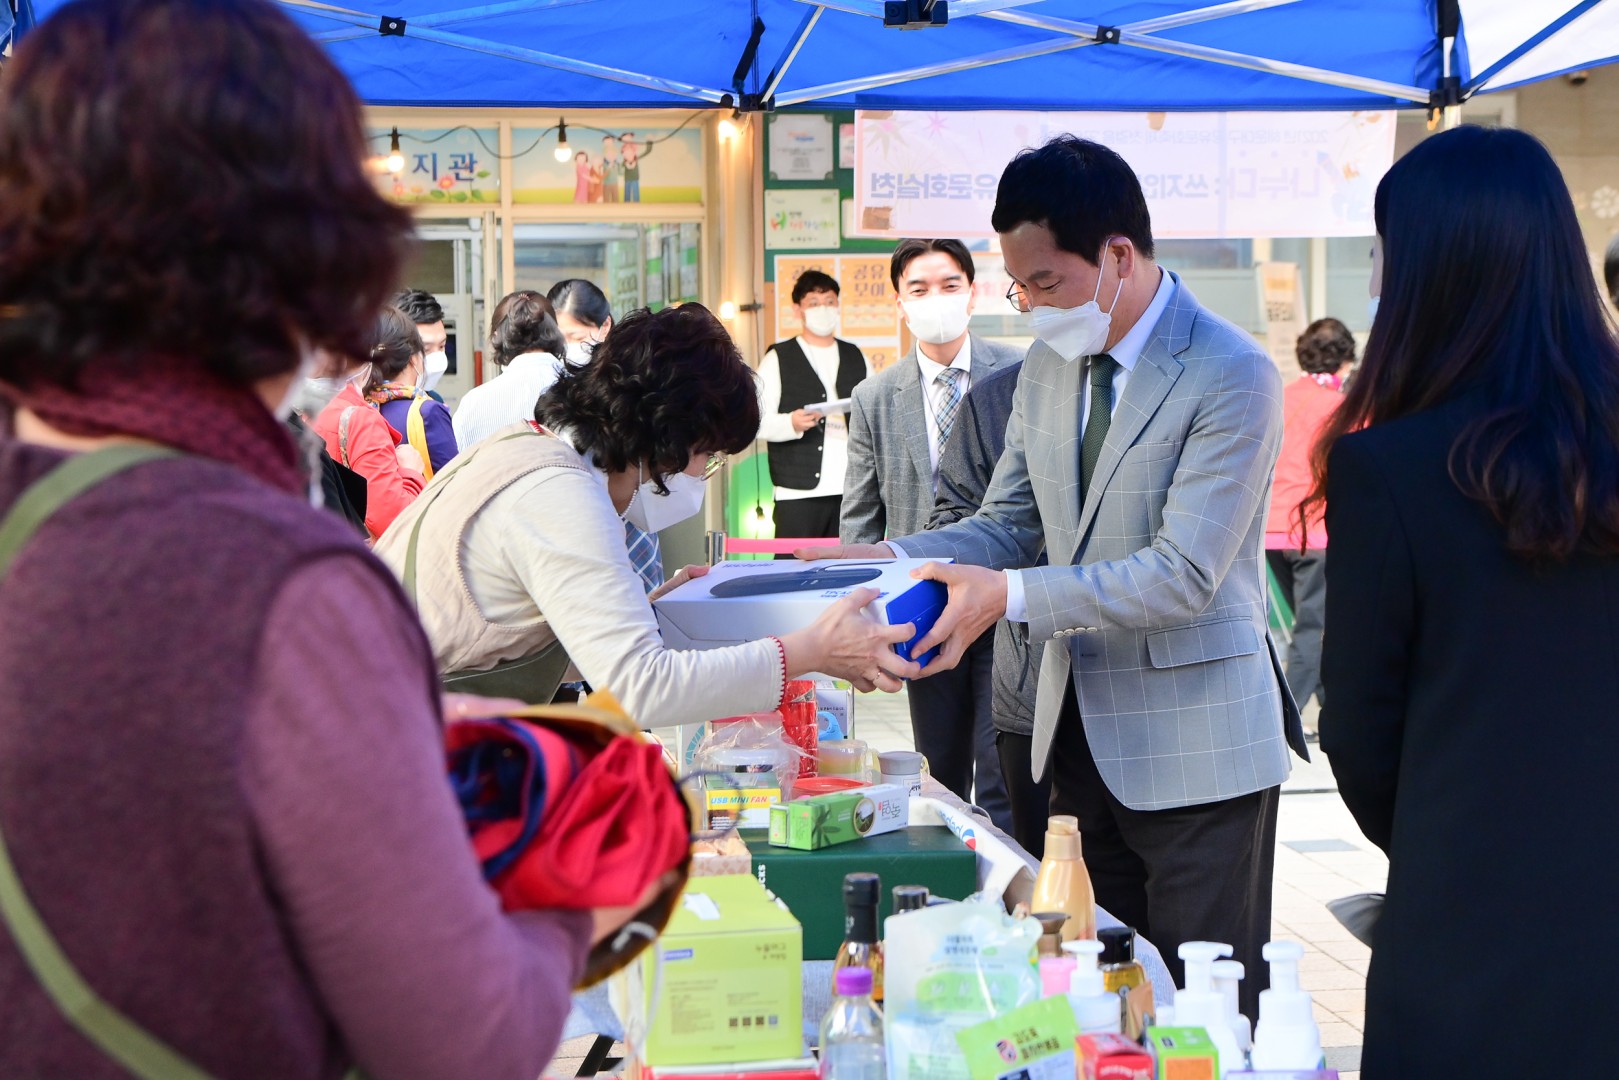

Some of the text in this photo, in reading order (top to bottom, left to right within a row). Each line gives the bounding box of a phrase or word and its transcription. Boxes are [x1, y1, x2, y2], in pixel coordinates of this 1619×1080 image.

[382, 152, 479, 182] 지관
[710, 795, 768, 804] USB MINI FAN
